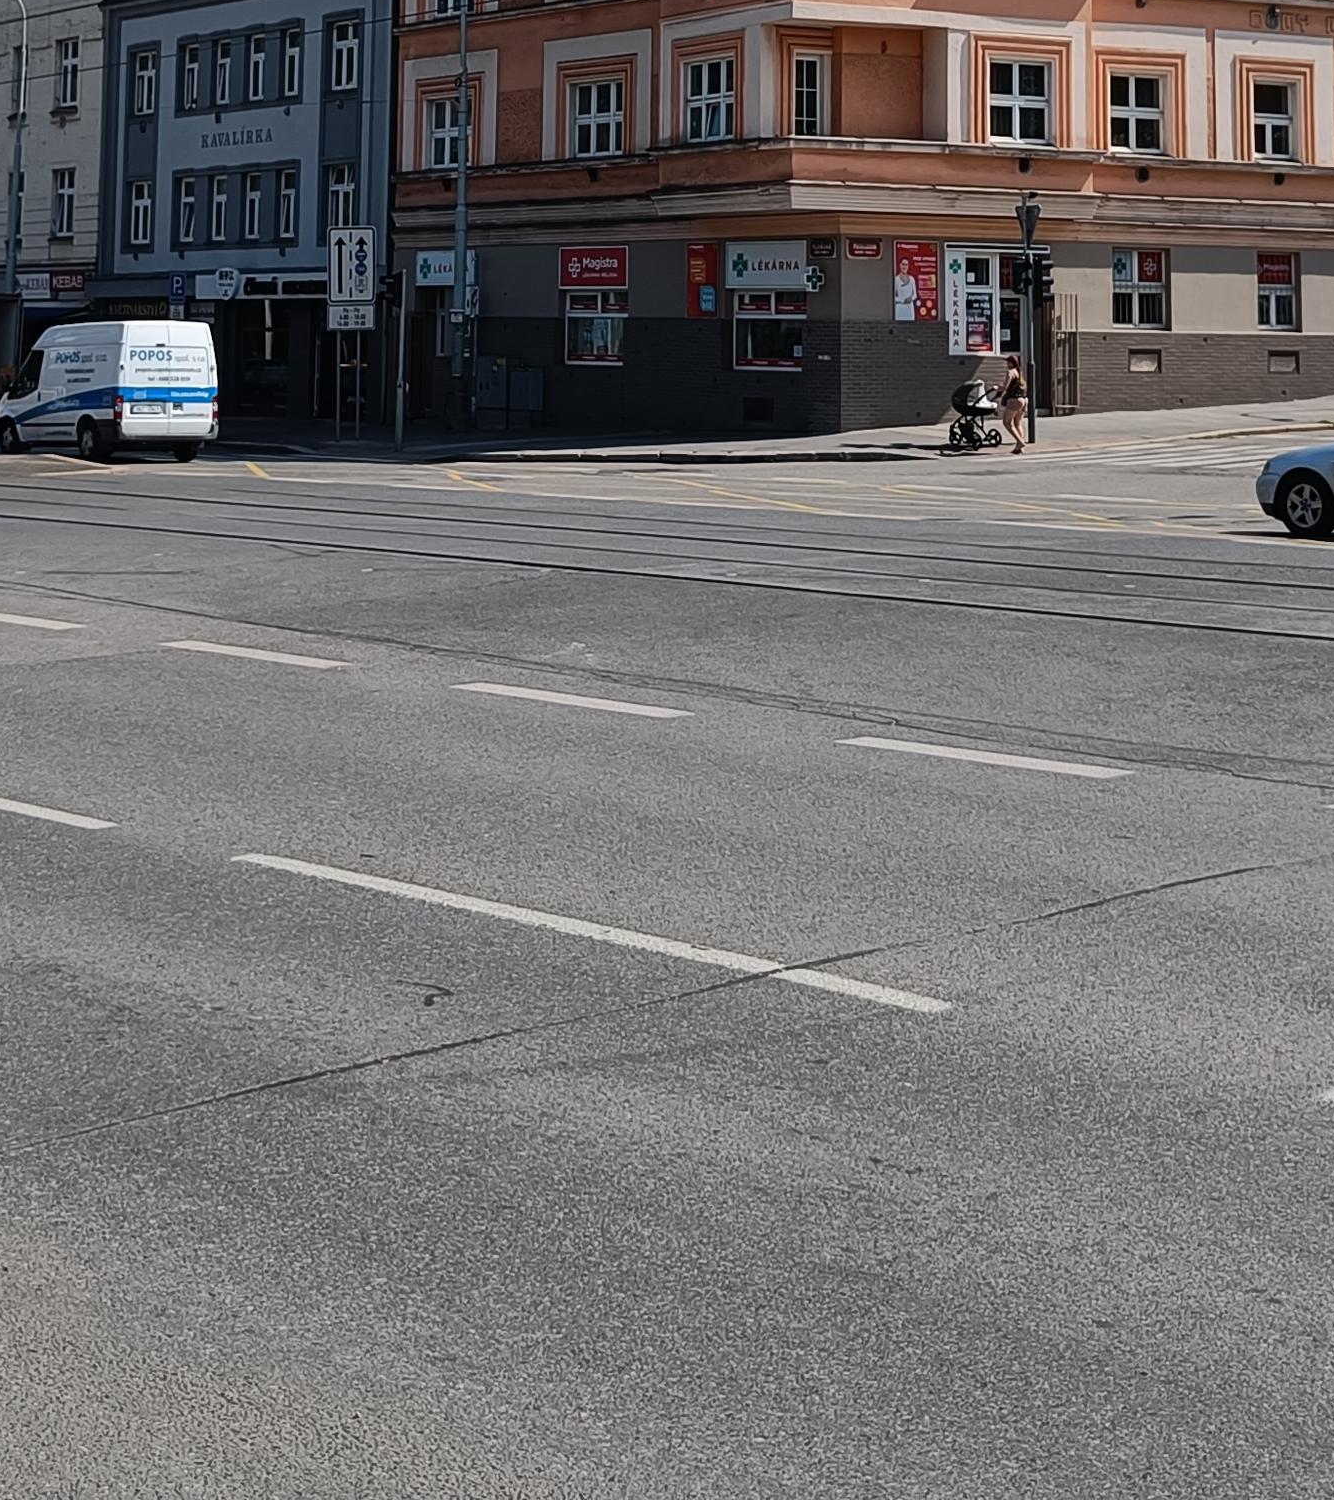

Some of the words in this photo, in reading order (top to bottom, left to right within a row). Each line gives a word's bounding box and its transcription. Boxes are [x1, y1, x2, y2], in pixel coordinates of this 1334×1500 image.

[1250, 9, 1310, 32] DMY
[201, 125, 273, 148] KAVALÍRKA
[582, 256, 618, 270] Magistra
[751, 258, 800, 271] LÉKÁRNA
[52, 275, 84, 288] KEBAB
[130, 350, 172, 361] POPOS
